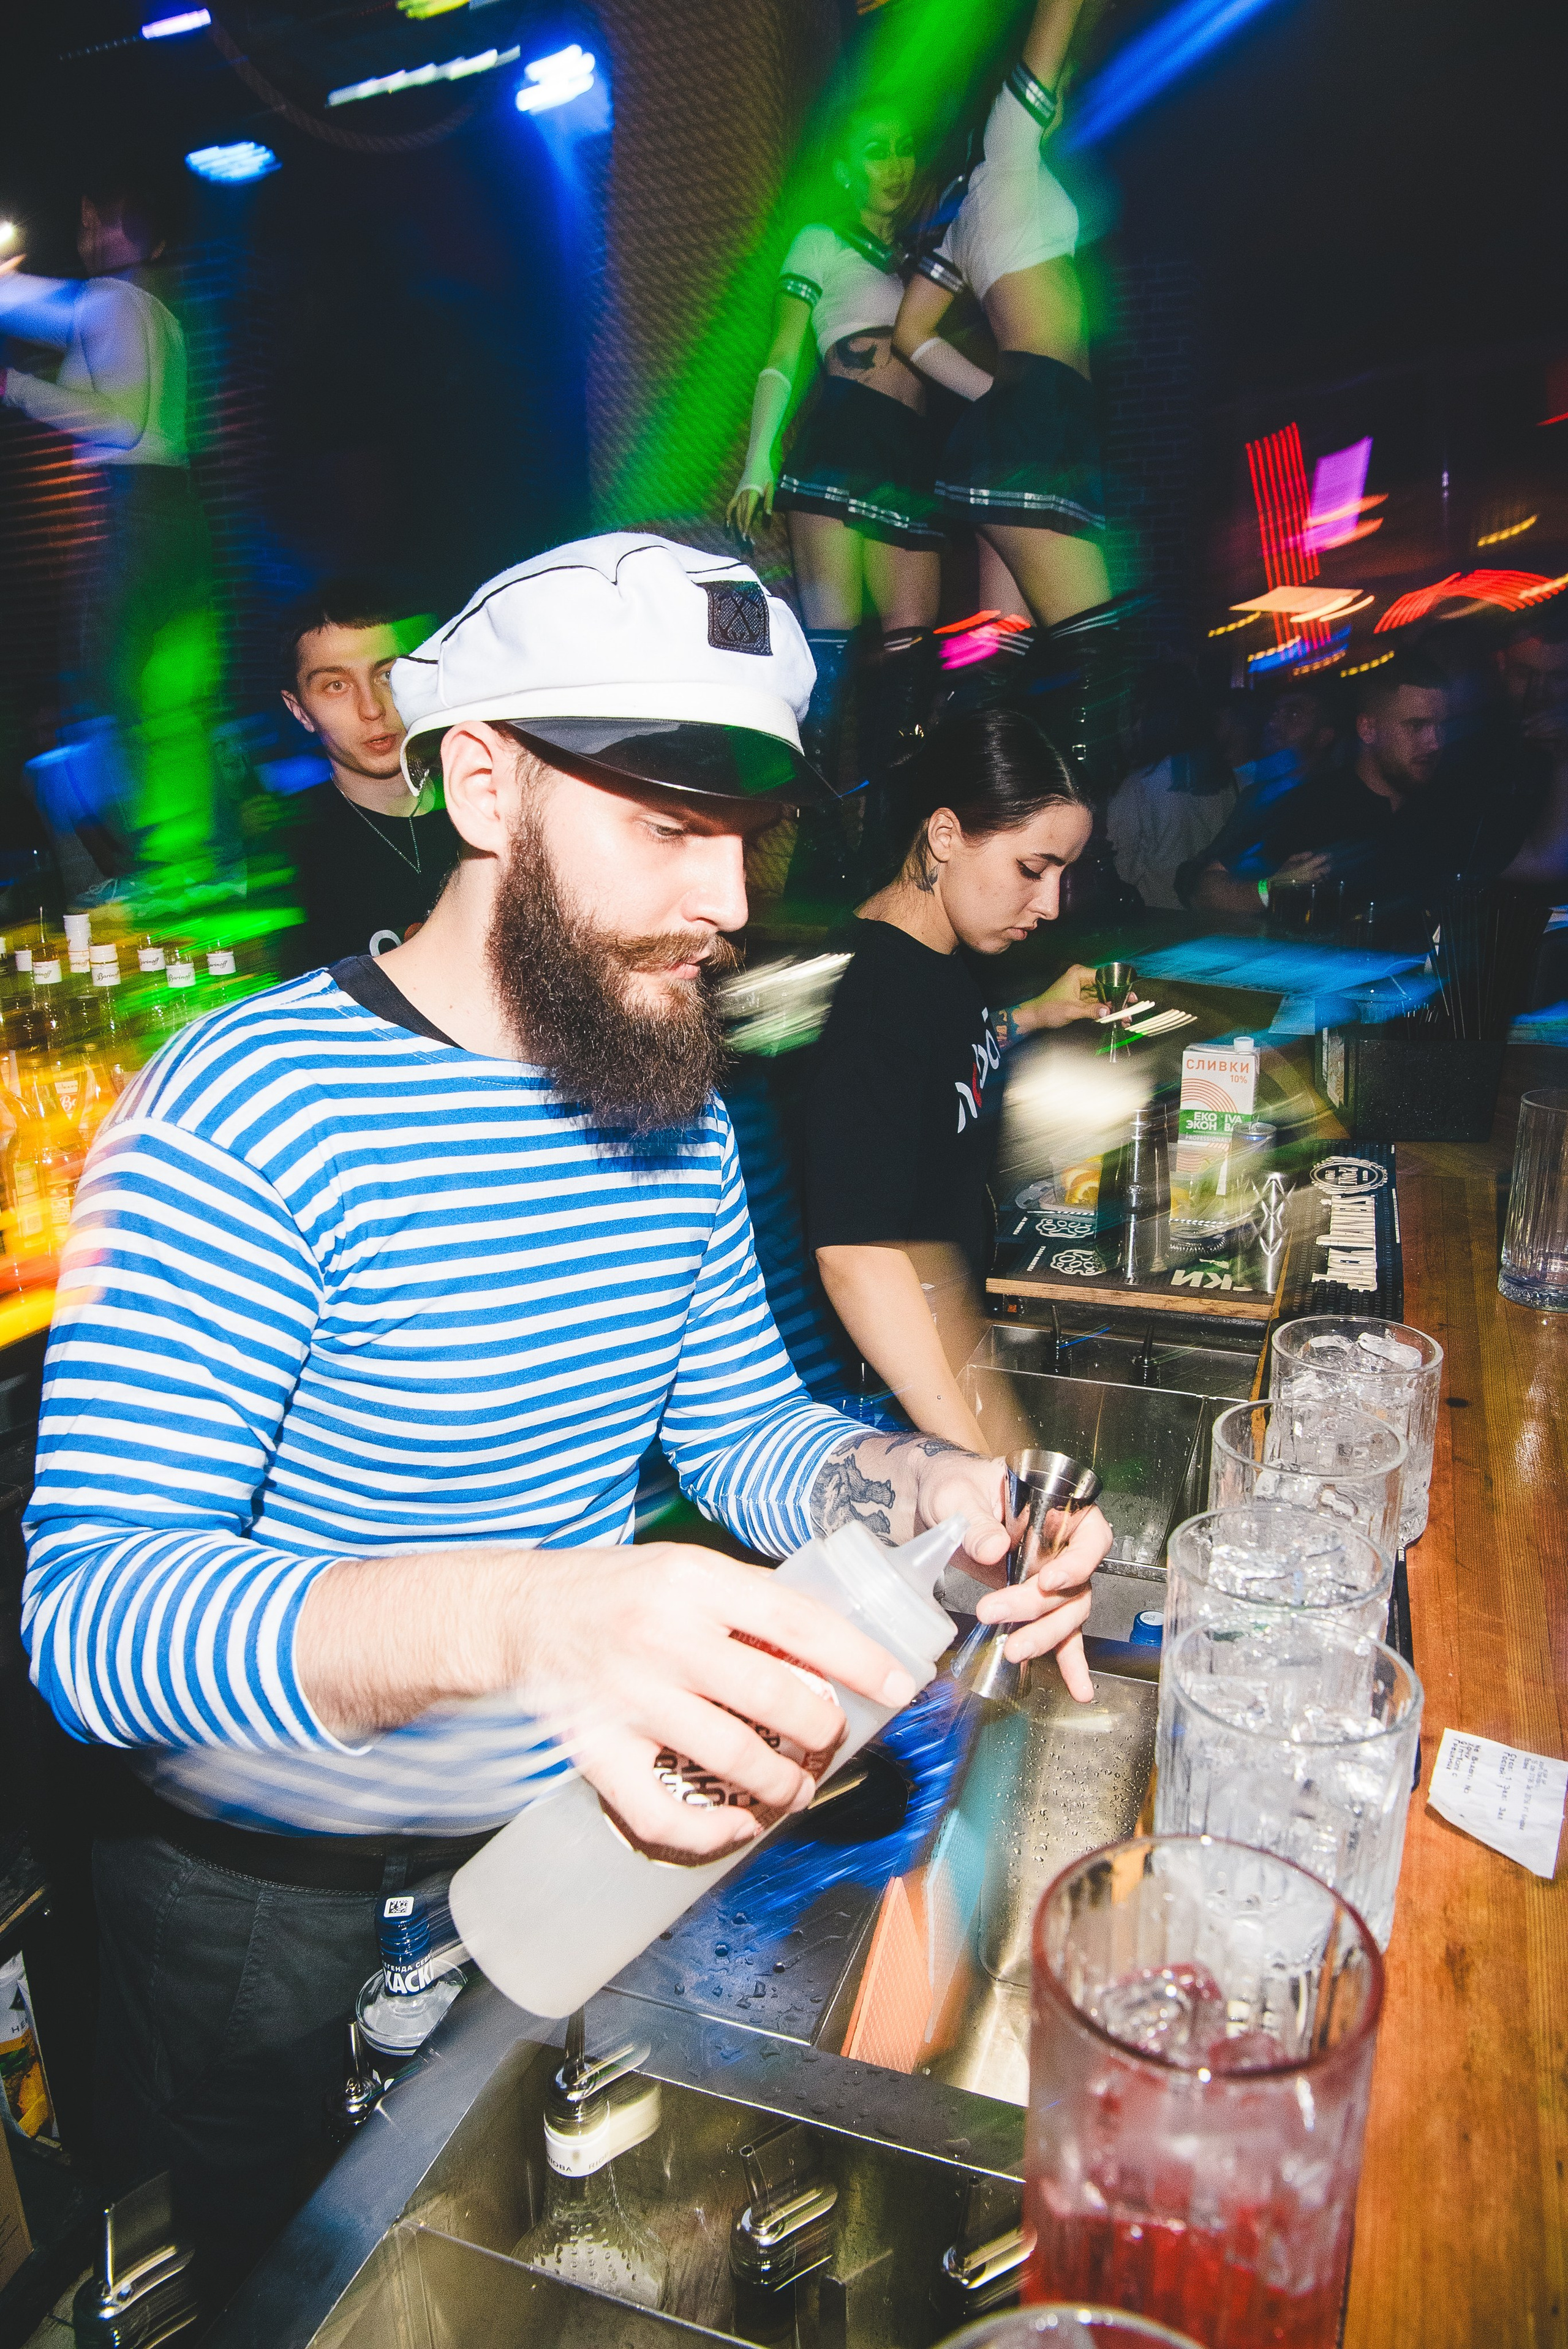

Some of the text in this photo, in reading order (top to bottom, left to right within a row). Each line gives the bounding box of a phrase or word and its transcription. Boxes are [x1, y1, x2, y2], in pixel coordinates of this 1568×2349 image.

[1186, 1059, 1249, 1073] СЛИВКИ
[1231, 1074, 1247, 1084] 10%
[1194, 1112, 1217, 1122] EKO
[1186, 1120, 1217, 1131] ЭКОН
[382, 1960, 413, 1973] ЕГЕНДА
